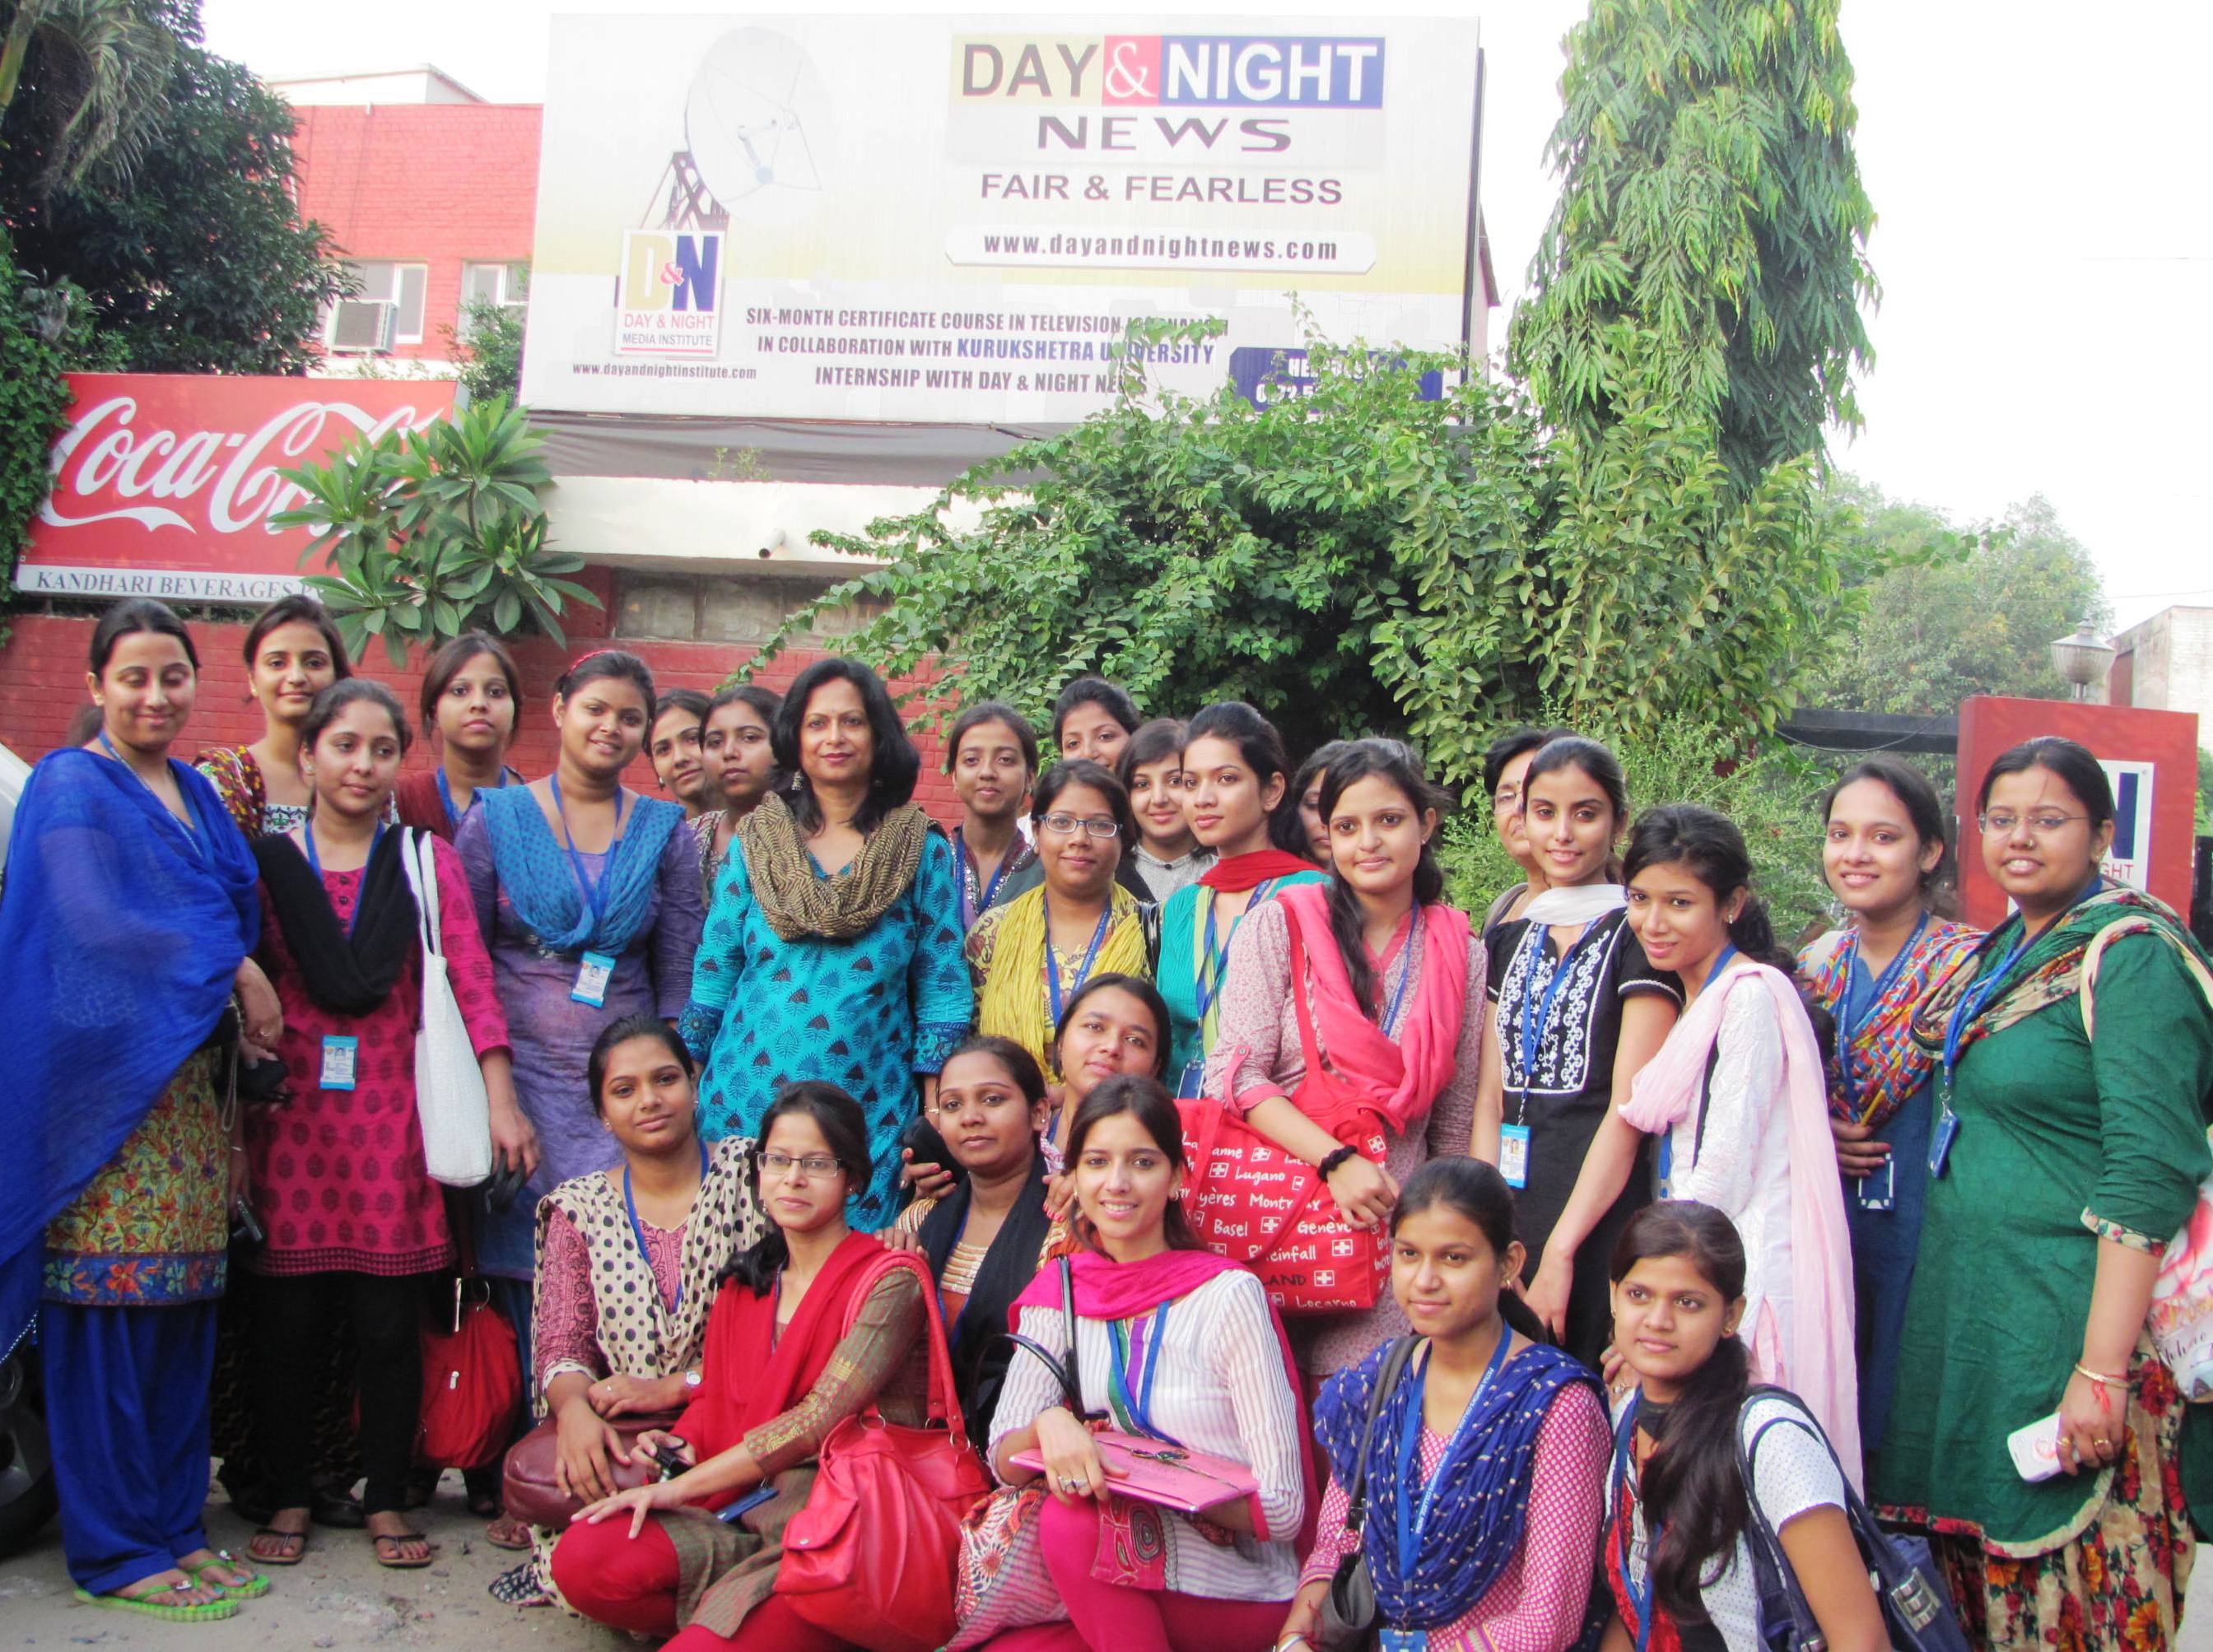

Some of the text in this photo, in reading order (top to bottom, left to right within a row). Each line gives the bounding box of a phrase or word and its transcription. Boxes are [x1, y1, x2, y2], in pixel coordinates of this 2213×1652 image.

[962, 41, 1378, 100] DAY & NIGHT
[1037, 115, 1291, 152] NEWS
[981, 174, 1343, 205] FAIR & FEARLESS
[984, 234, 1338, 260] www.dayandnightnews.com
[624, 314, 715, 329] DAY & NIGHT
[747, 308, 834, 326] SIX-MONTH
[838, 309, 937, 328] CERTIFICATE
[941, 312, 1004, 330] COURSE
[1009, 314, 1025, 330] IN
[1031, 314, 1120, 333] TELEVISION
[622, 333, 712, 347] MEDIA INSTITUTE
[757, 336, 1214, 365] IN COLLABORATION WITH KURUKSHETRA UIVERSITY
[573, 363, 757, 379] www.dayandnightinstitute.com
[815, 367, 1147, 395] INTERNSHIP WITH DAY & NIGHT NES
[40, 397, 444, 537] Coca-Co
[38, 571, 154, 593] KANDHARI
[161, 576, 294, 598] BEVERAGES
[1235, 1166, 1285, 1185] Lugano
[1214, 1218, 1248, 1236] Basel
